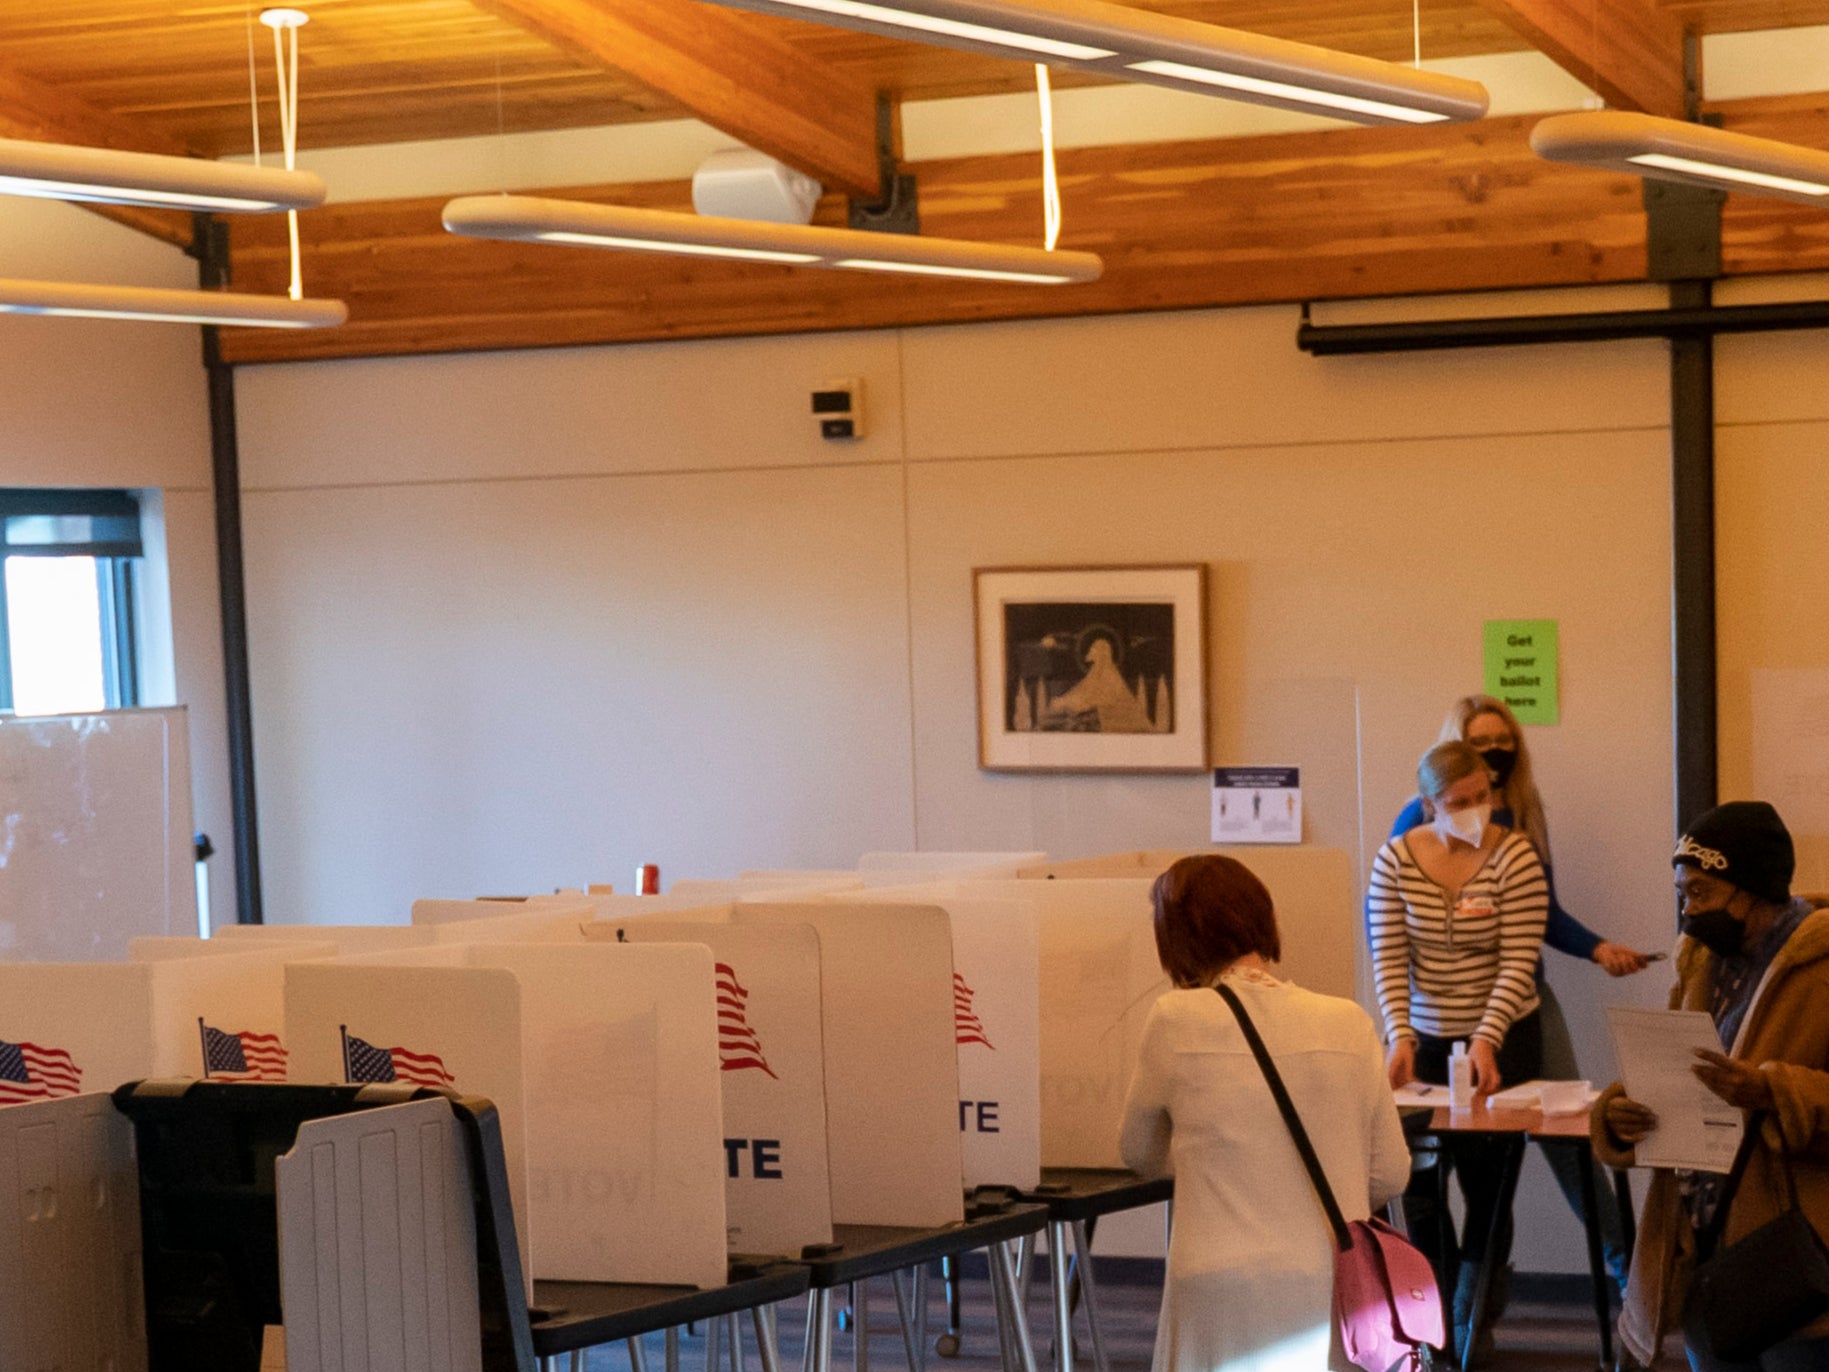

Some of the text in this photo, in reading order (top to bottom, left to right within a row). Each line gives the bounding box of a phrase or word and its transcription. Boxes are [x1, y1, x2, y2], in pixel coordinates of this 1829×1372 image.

[1506, 633, 1532, 647] Get
[1504, 657, 1535, 670] your
[1500, 676, 1541, 687] ballot
[1504, 696, 1536, 707] here
[958, 1100, 1000, 1133] TE
[723, 1138, 783, 1179] TE
